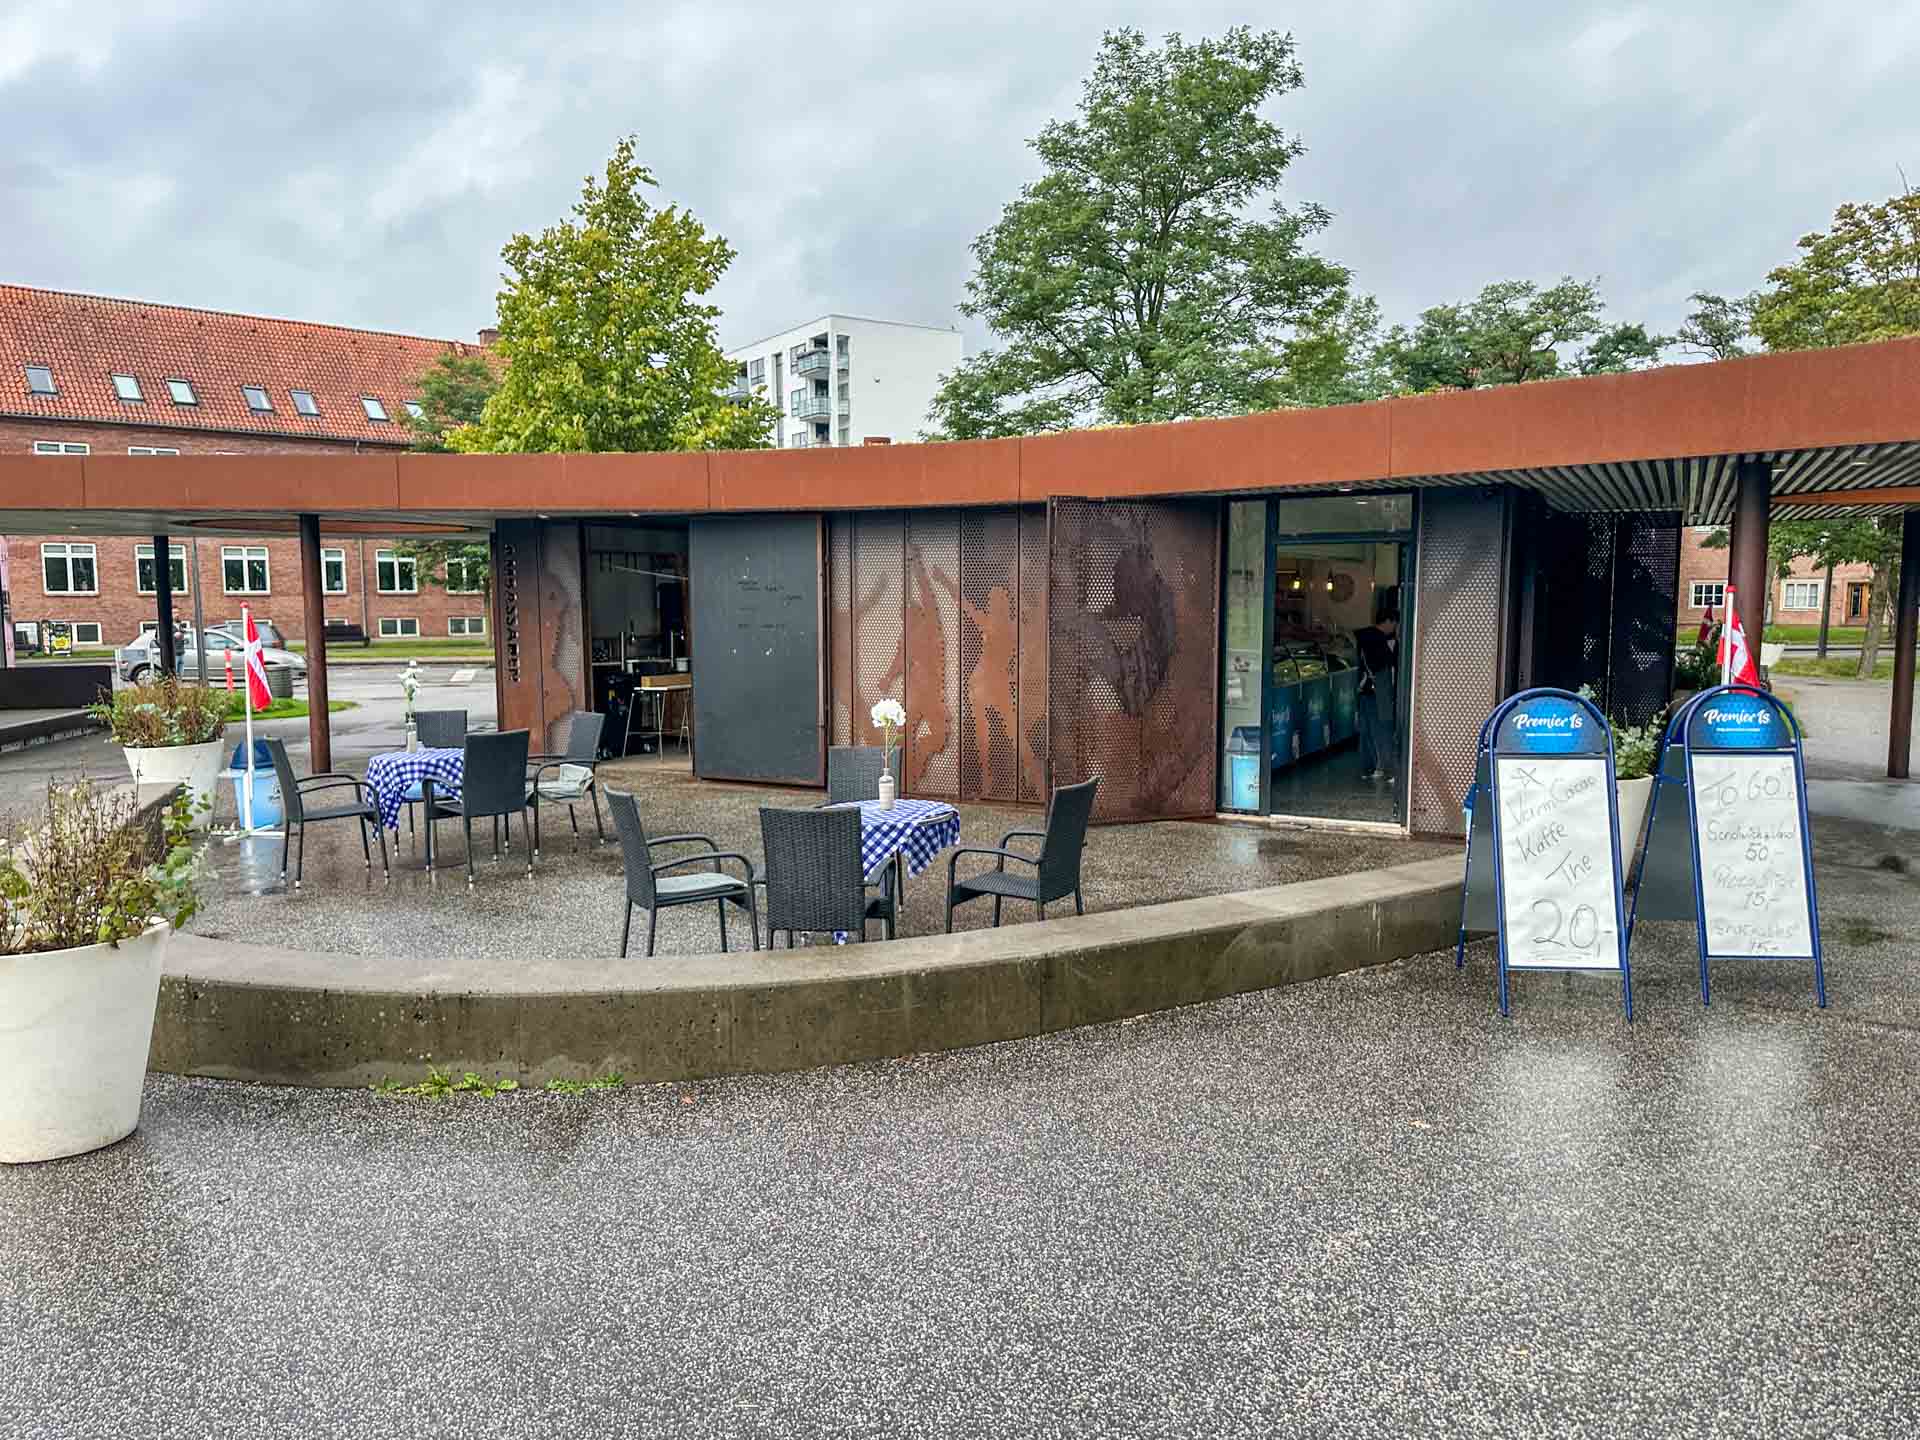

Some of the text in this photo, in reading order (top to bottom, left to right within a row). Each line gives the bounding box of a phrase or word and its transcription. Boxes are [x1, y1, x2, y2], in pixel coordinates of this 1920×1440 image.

[1513, 713, 1568, 729] Premier
[1703, 709, 1756, 724] Premier
[1515, 822, 1568, 863] Kaffe
[1545, 850, 1593, 888] The
